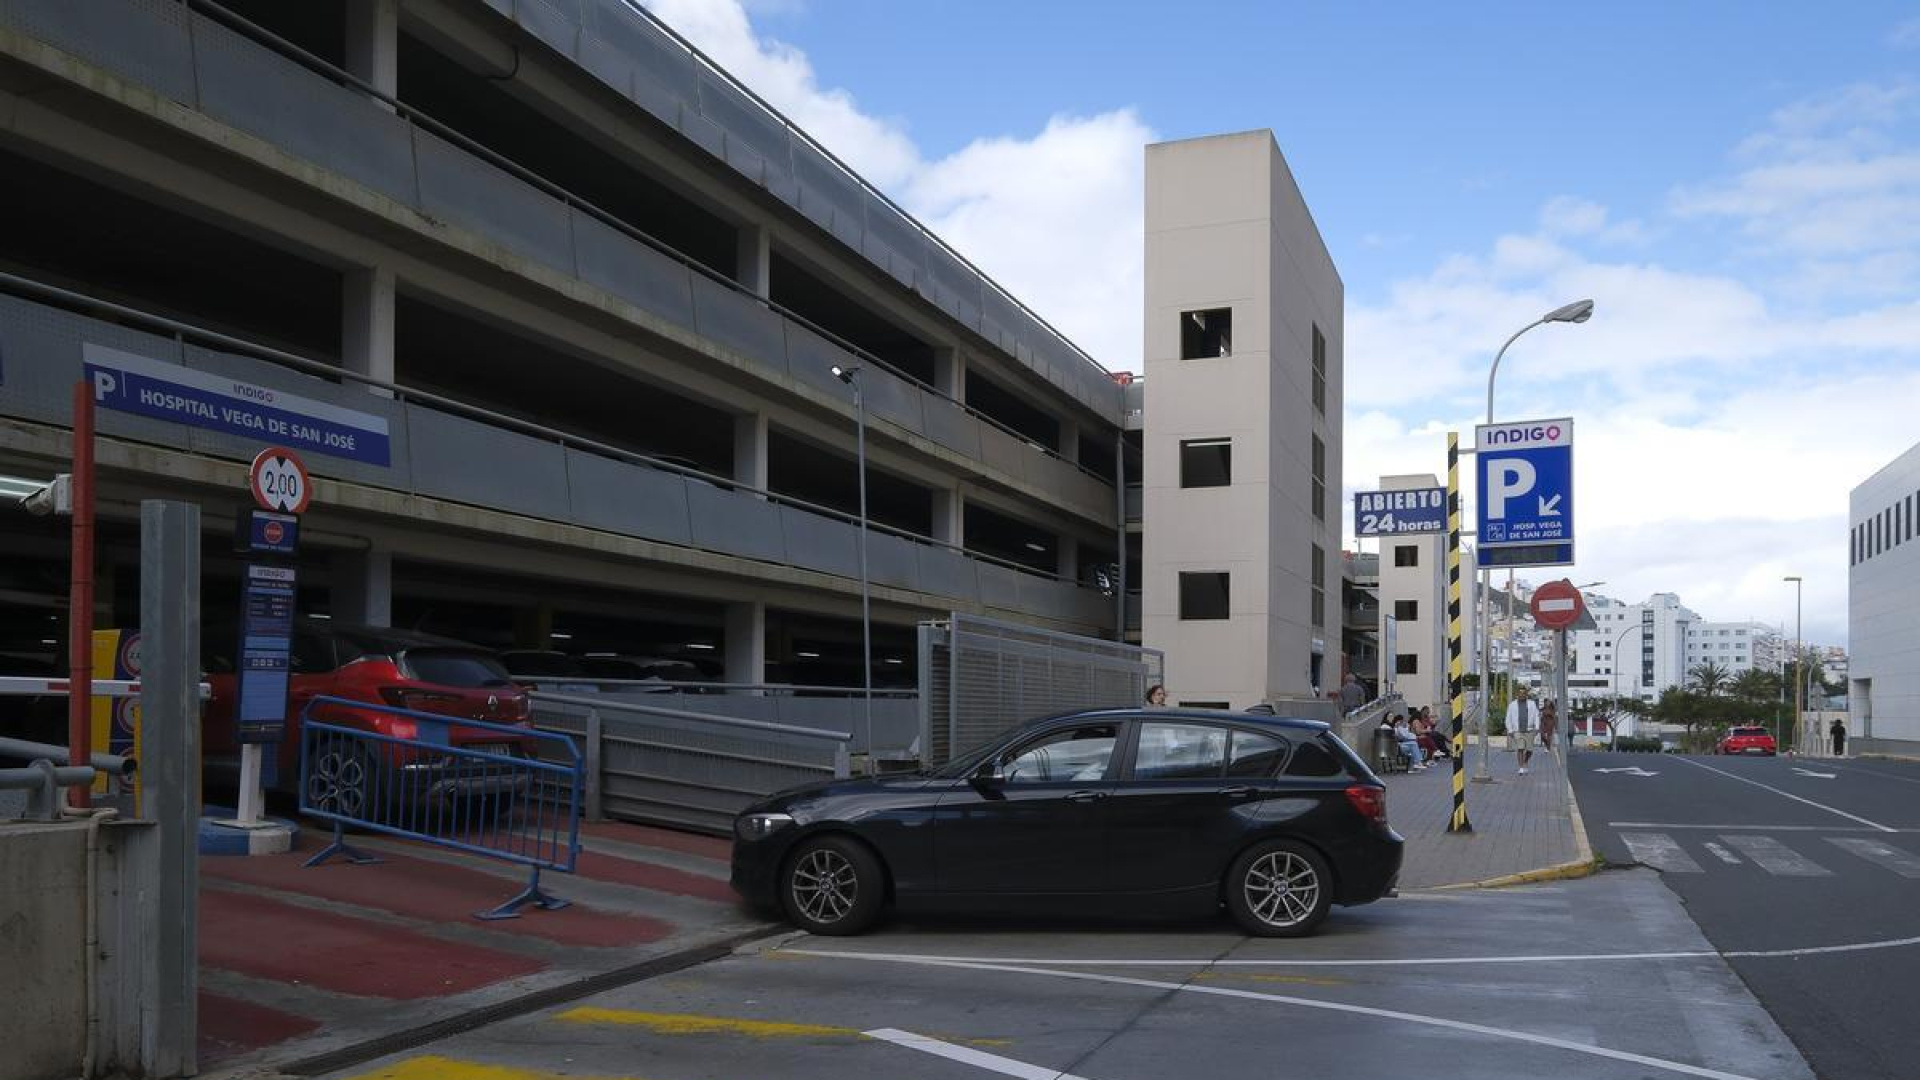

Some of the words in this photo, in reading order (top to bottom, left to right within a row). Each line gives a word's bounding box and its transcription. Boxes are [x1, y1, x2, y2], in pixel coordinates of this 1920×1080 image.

[233, 384, 273, 402] INDIGO
[94, 371, 116, 400] P
[140, 389, 218, 419] HOSPITAL
[221, 407, 264, 430] VEGA
[268, 419, 288, 435] DE
[291, 424, 321, 443] SAN
[324, 431, 356, 450] JOSÉ
[1487, 425, 1561, 445] INDIGO
[265, 471, 297, 499] 2,00
[1487, 458, 1537, 520] P
[1361, 490, 1442, 511] ABIERTO
[1362, 513, 1396, 534] 24
[1398, 520, 1441, 532] horas
[1522, 530, 1540, 538] SAN
[1539, 521, 1562, 529] VEGA
